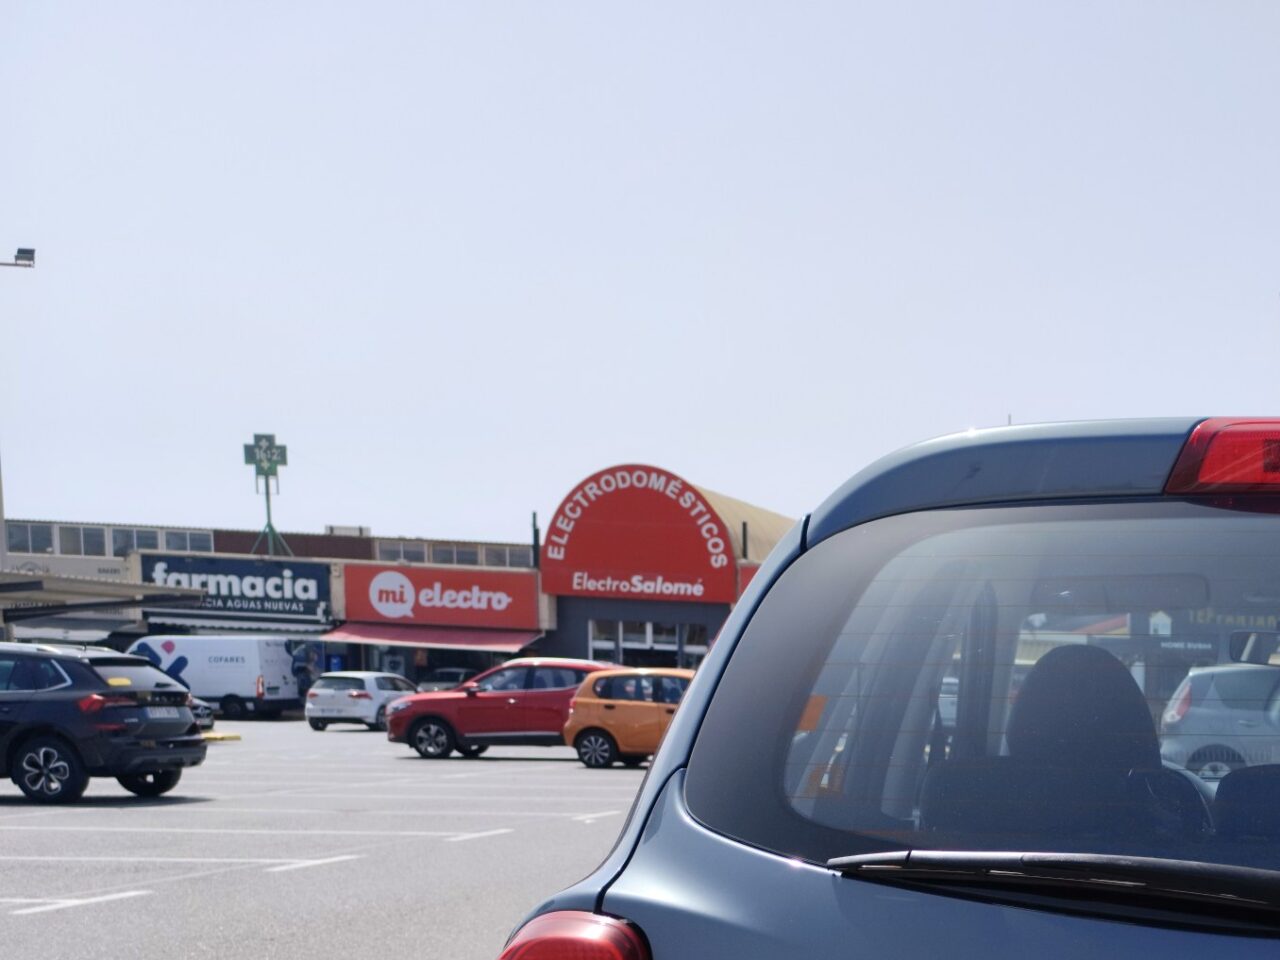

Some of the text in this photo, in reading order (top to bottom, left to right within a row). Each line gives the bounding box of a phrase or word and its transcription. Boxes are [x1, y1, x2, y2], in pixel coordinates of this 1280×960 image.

[547, 470, 728, 569] ELECTRODOMÉSTICOS
[152, 562, 318, 600] farmacia
[378, 582, 513, 611] mi electro
[227, 600, 262, 610] AGUAS
[264, 602, 304, 612] NUEVAS
